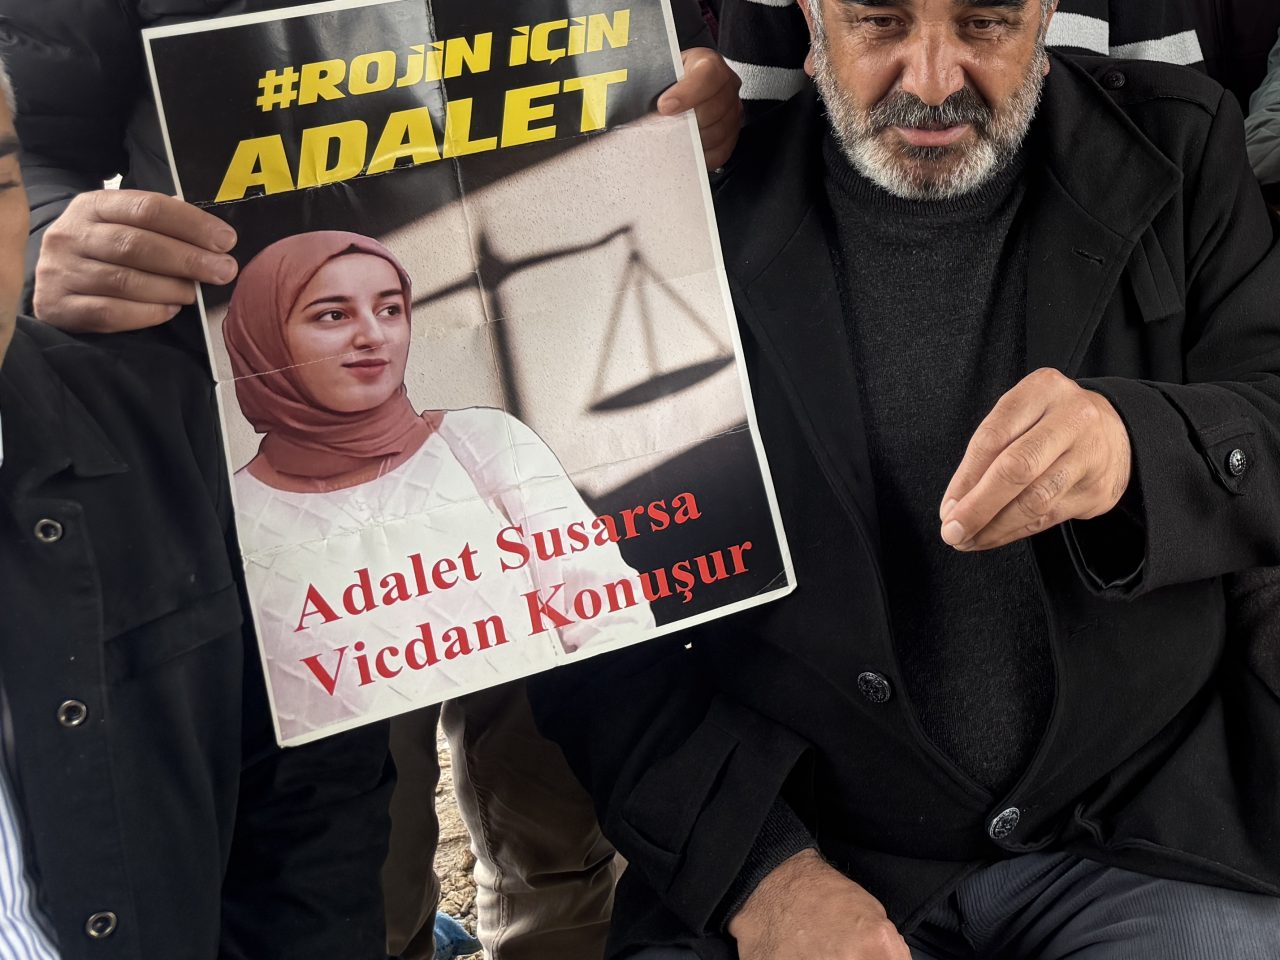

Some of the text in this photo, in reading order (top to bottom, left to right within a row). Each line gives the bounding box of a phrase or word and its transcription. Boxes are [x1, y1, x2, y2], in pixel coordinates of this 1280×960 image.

[508, 7, 631, 66] İÇİN
[213, 68, 628, 203] ADALET
[293, 490, 703, 633] Adalet Susarsa
[299, 539, 754, 697] Vicdan Konuşur
